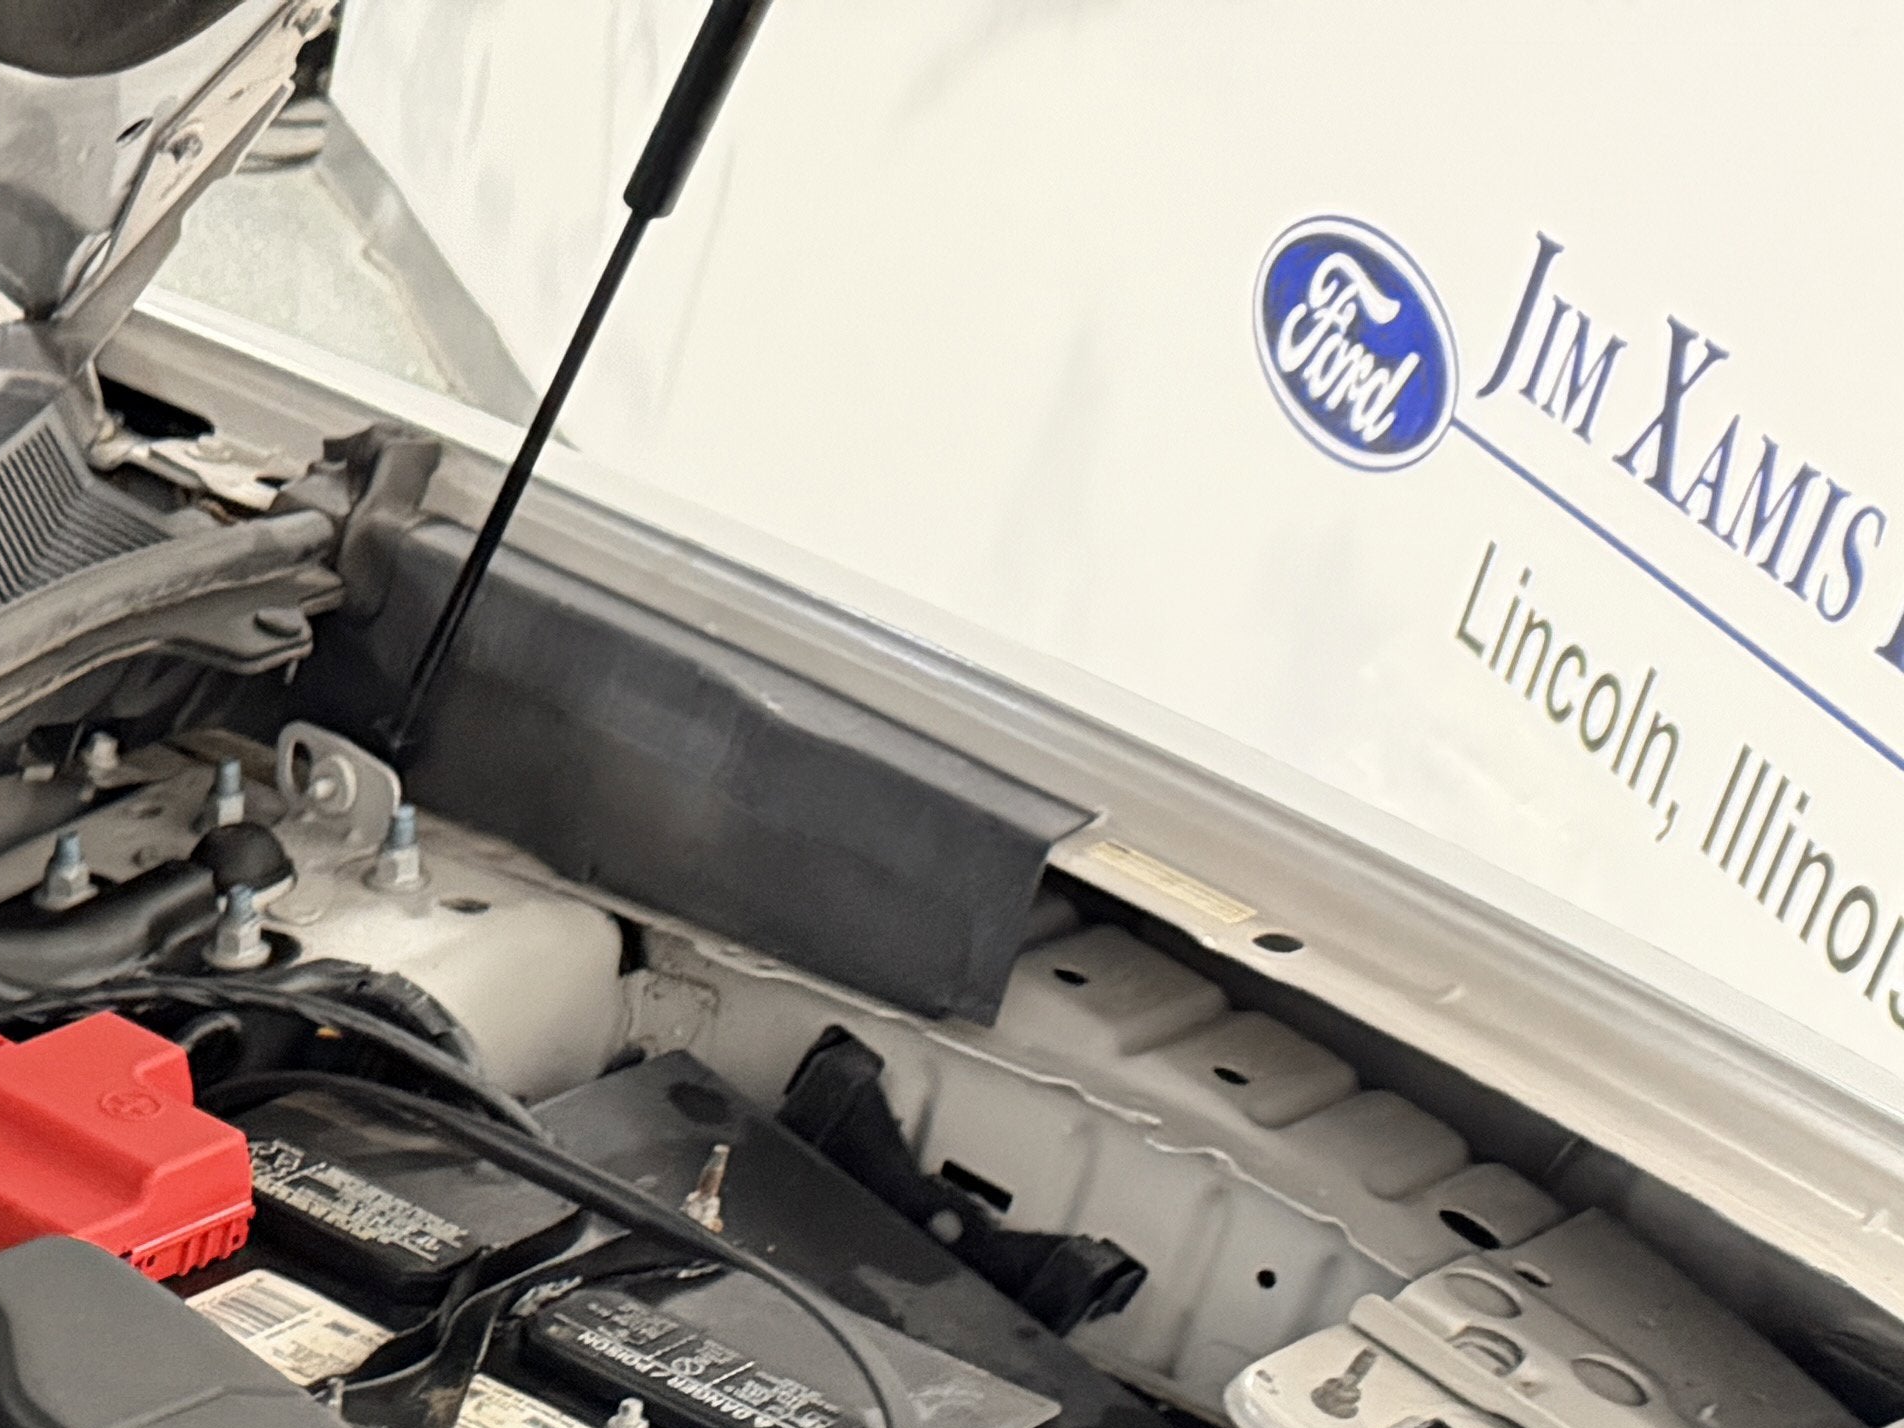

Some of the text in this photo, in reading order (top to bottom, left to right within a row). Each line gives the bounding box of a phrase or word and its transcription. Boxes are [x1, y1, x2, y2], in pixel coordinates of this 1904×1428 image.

[1277, 250, 1424, 444] Ford
[1454, 539, 1682, 844] Lincoln,
[667, 1374, 751, 1423] DANGER
